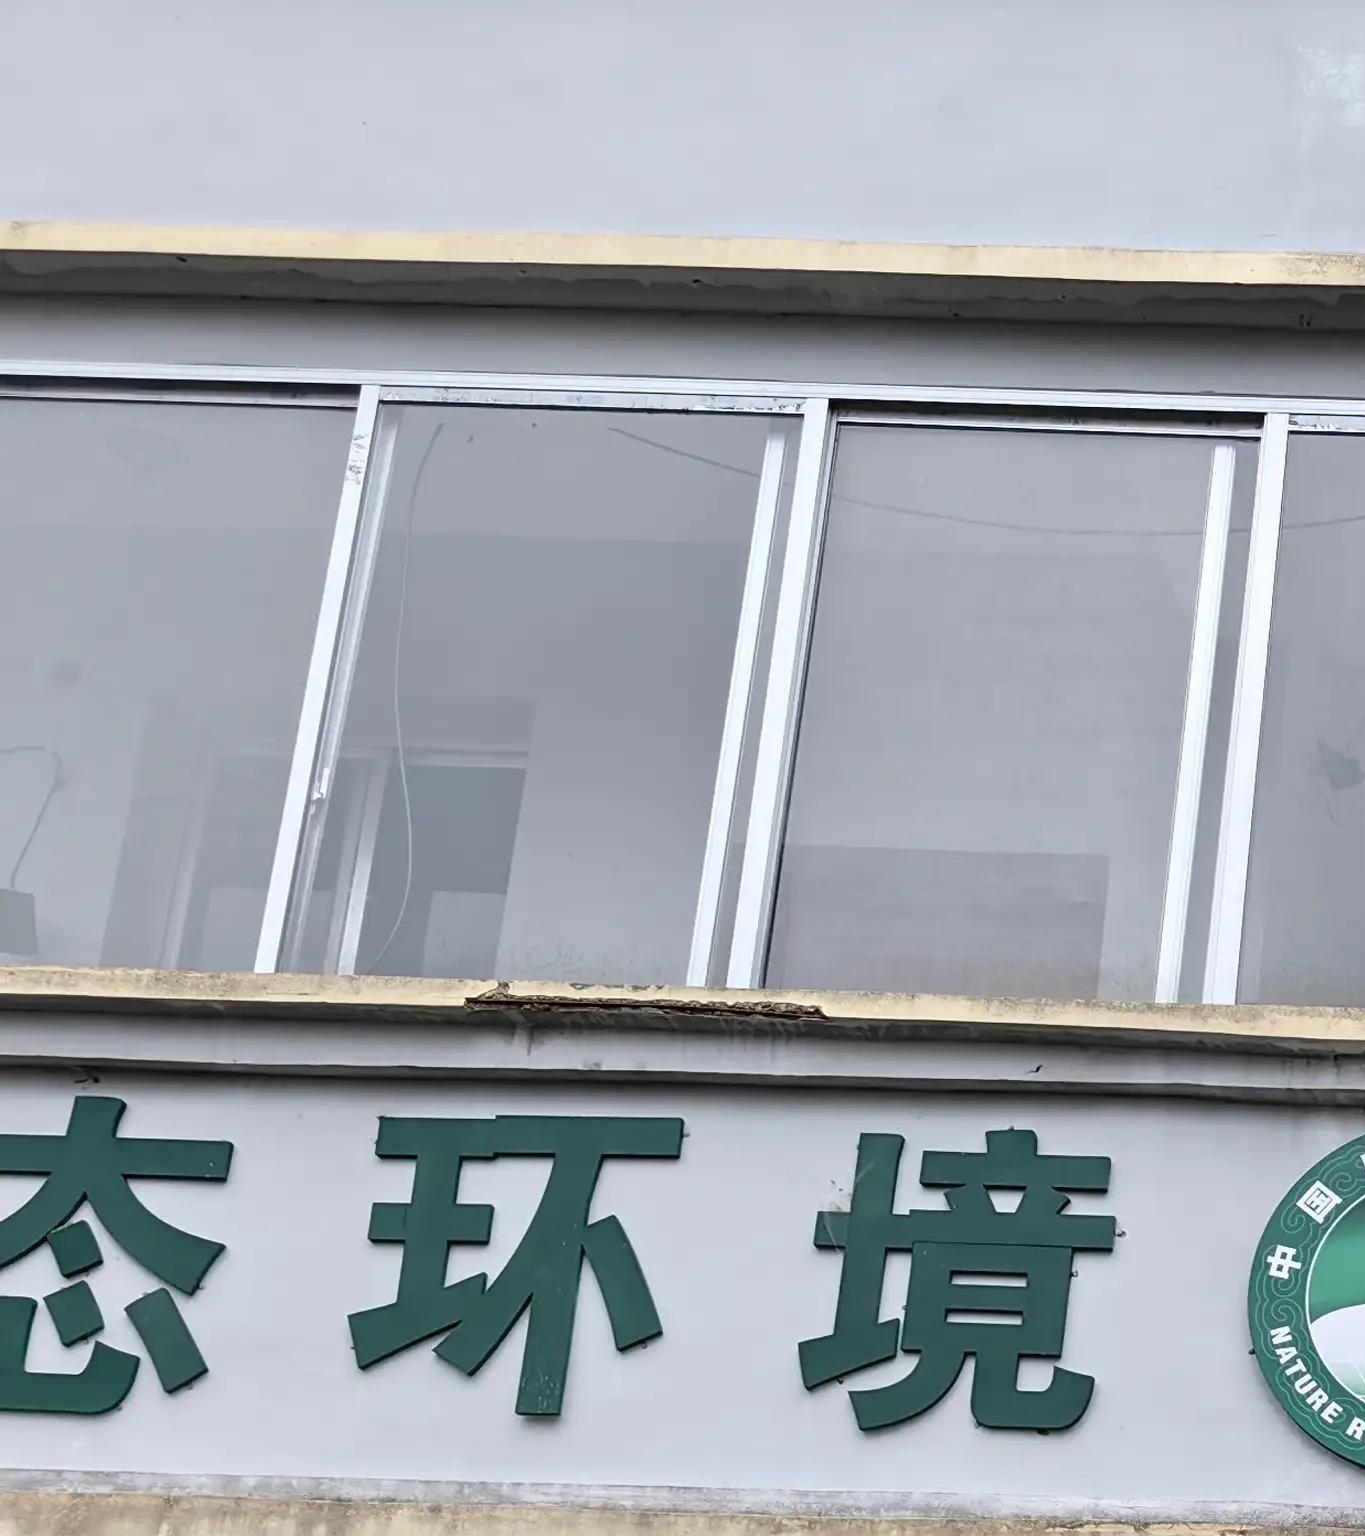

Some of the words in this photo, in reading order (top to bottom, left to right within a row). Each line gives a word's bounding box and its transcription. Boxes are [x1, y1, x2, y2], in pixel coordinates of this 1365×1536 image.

[0, 1095, 1117, 1432] 态环境
[1270, 1325, 1344, 1424] NATURE
